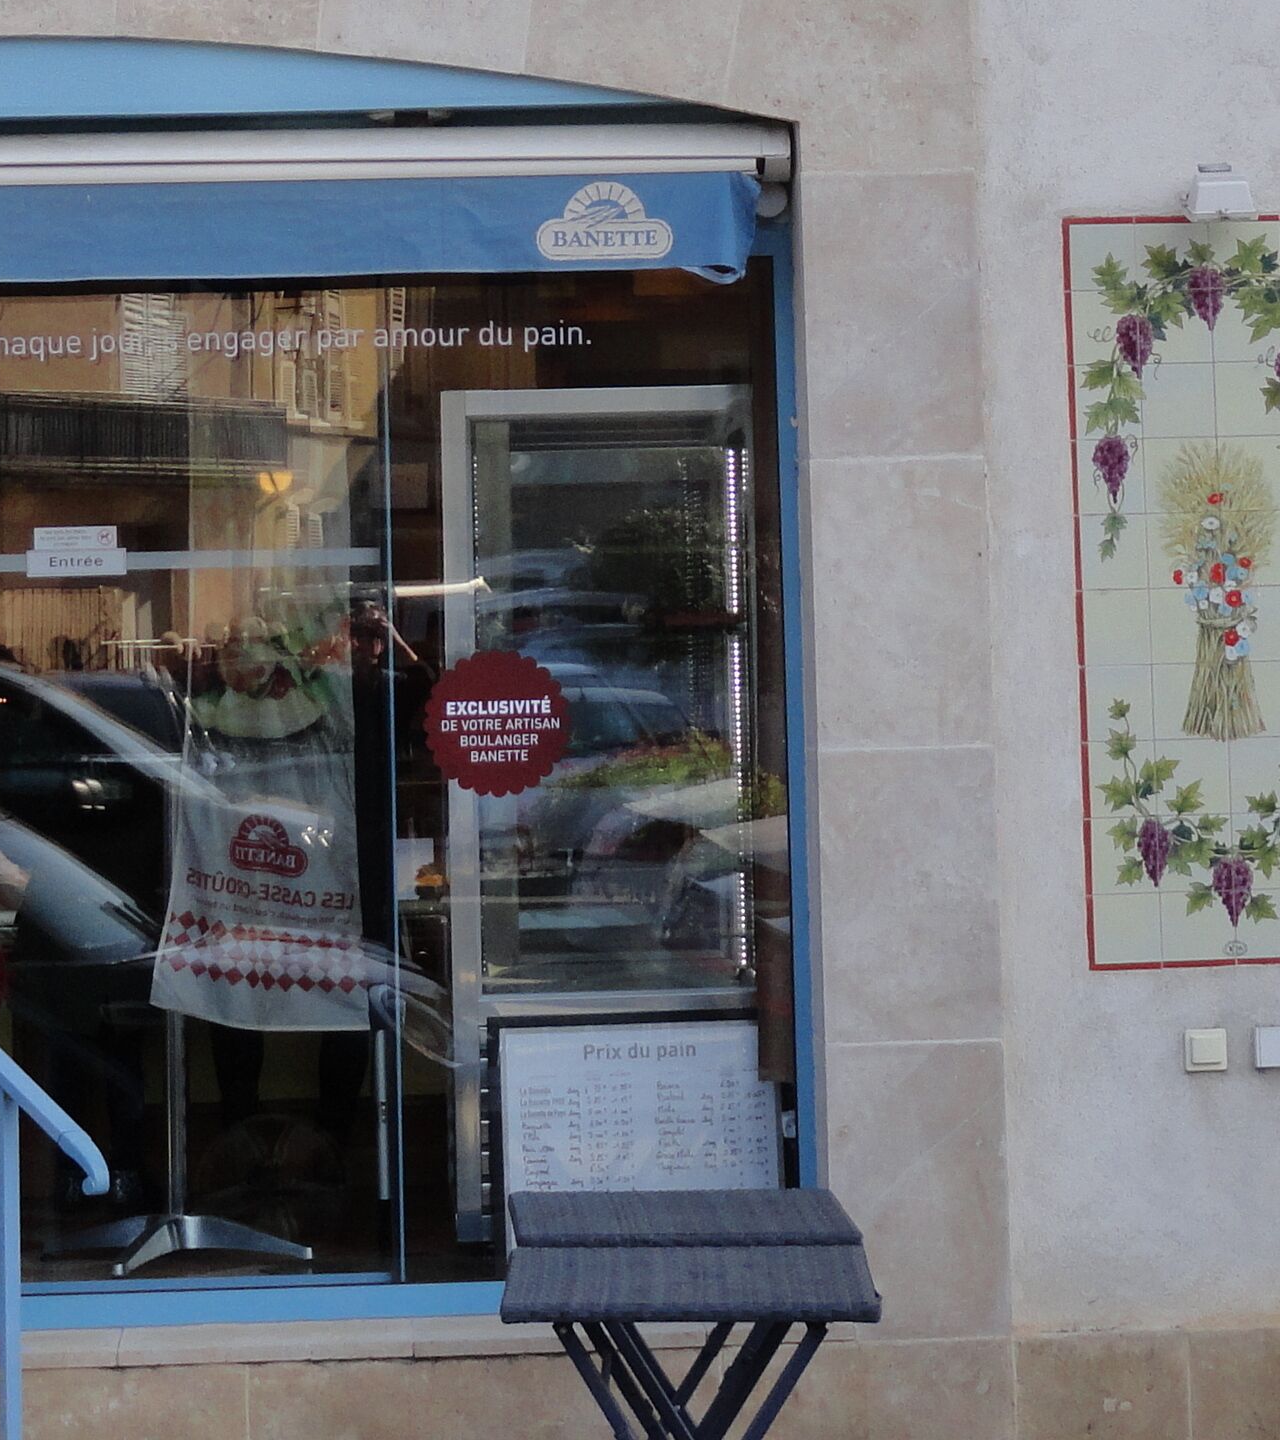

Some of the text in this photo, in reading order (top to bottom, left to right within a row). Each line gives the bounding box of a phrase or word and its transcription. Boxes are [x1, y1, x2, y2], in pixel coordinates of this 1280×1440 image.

[551, 228, 658, 249] BANETTE
[318, 328, 363, 351] par
[373, 323, 470, 348] amour
[479, 320, 518, 347] du
[524, 319, 593, 353] pain.
[48, 555, 104, 568] Entrée
[445, 694, 552, 716] EXCLUSIVITÉ
[440, 716, 561, 733] DE VOTRE ARTISAN
[459, 732, 539, 748] BOULANGER
[470, 748, 529, 763] BANETTE
[583, 1042, 697, 1061] Prix du pain
